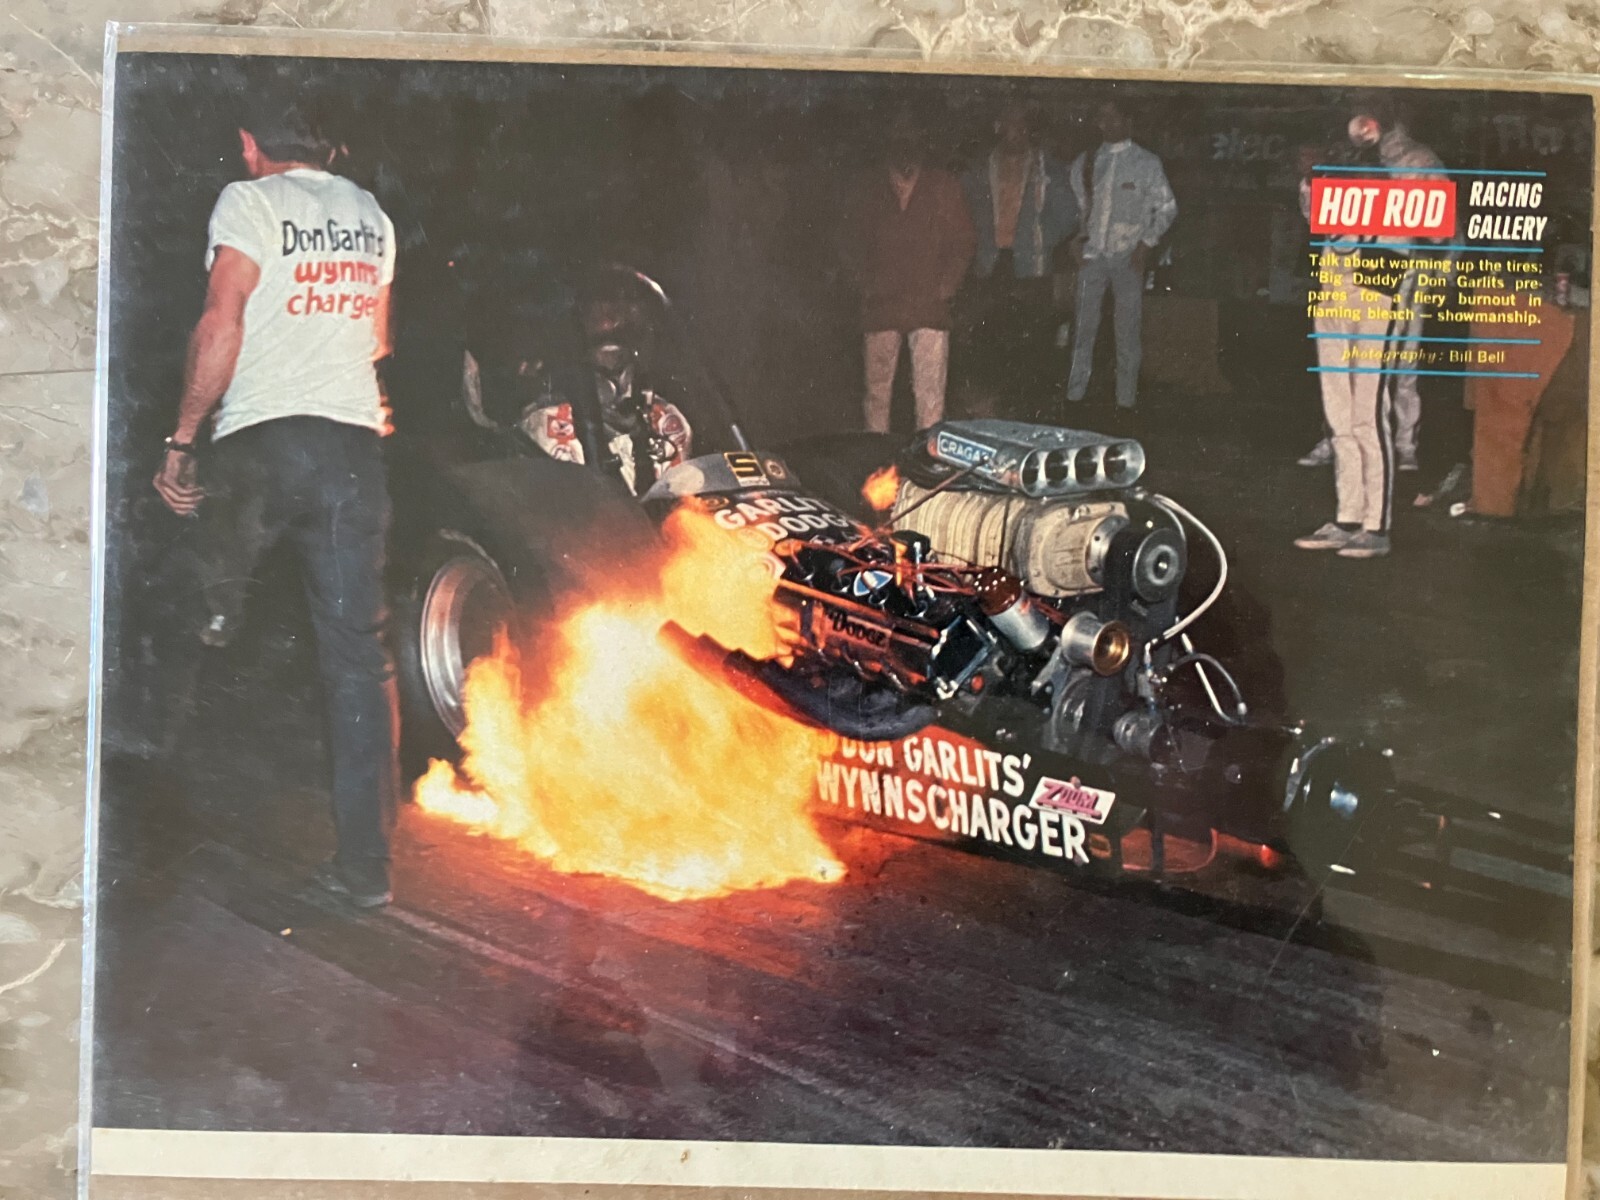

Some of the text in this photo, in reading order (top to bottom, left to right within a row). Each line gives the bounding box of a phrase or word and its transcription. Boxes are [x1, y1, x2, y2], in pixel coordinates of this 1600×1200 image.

[1469, 181, 1543, 208] RACING
[1318, 187, 1447, 228] HOT ROD
[282, 219, 325, 256] Don
[1467, 214, 1548, 241] GALLERY
[1309, 253, 1339, 267] Talk
[1344, 255, 1385, 269] about
[1389, 257, 1451, 273] warming
[1456, 260, 1474, 274] up
[1479, 258, 1502, 272] the
[1418, 273, 1446, 287] Don
[1457, 274, 1505, 289] Garlits
[1516, 278, 1543, 292] pre-
[1308, 288, 1542, 307] pares for a fiery burnout in
[1307, 304, 1360, 321] flaming
[1367, 306, 1414, 321] bleach
[1437, 308, 1541, 327] showmanship.
[1341, 345, 1505, 364] photography: Bill Bell
[903, 736, 1031, 798] GARLITS'
